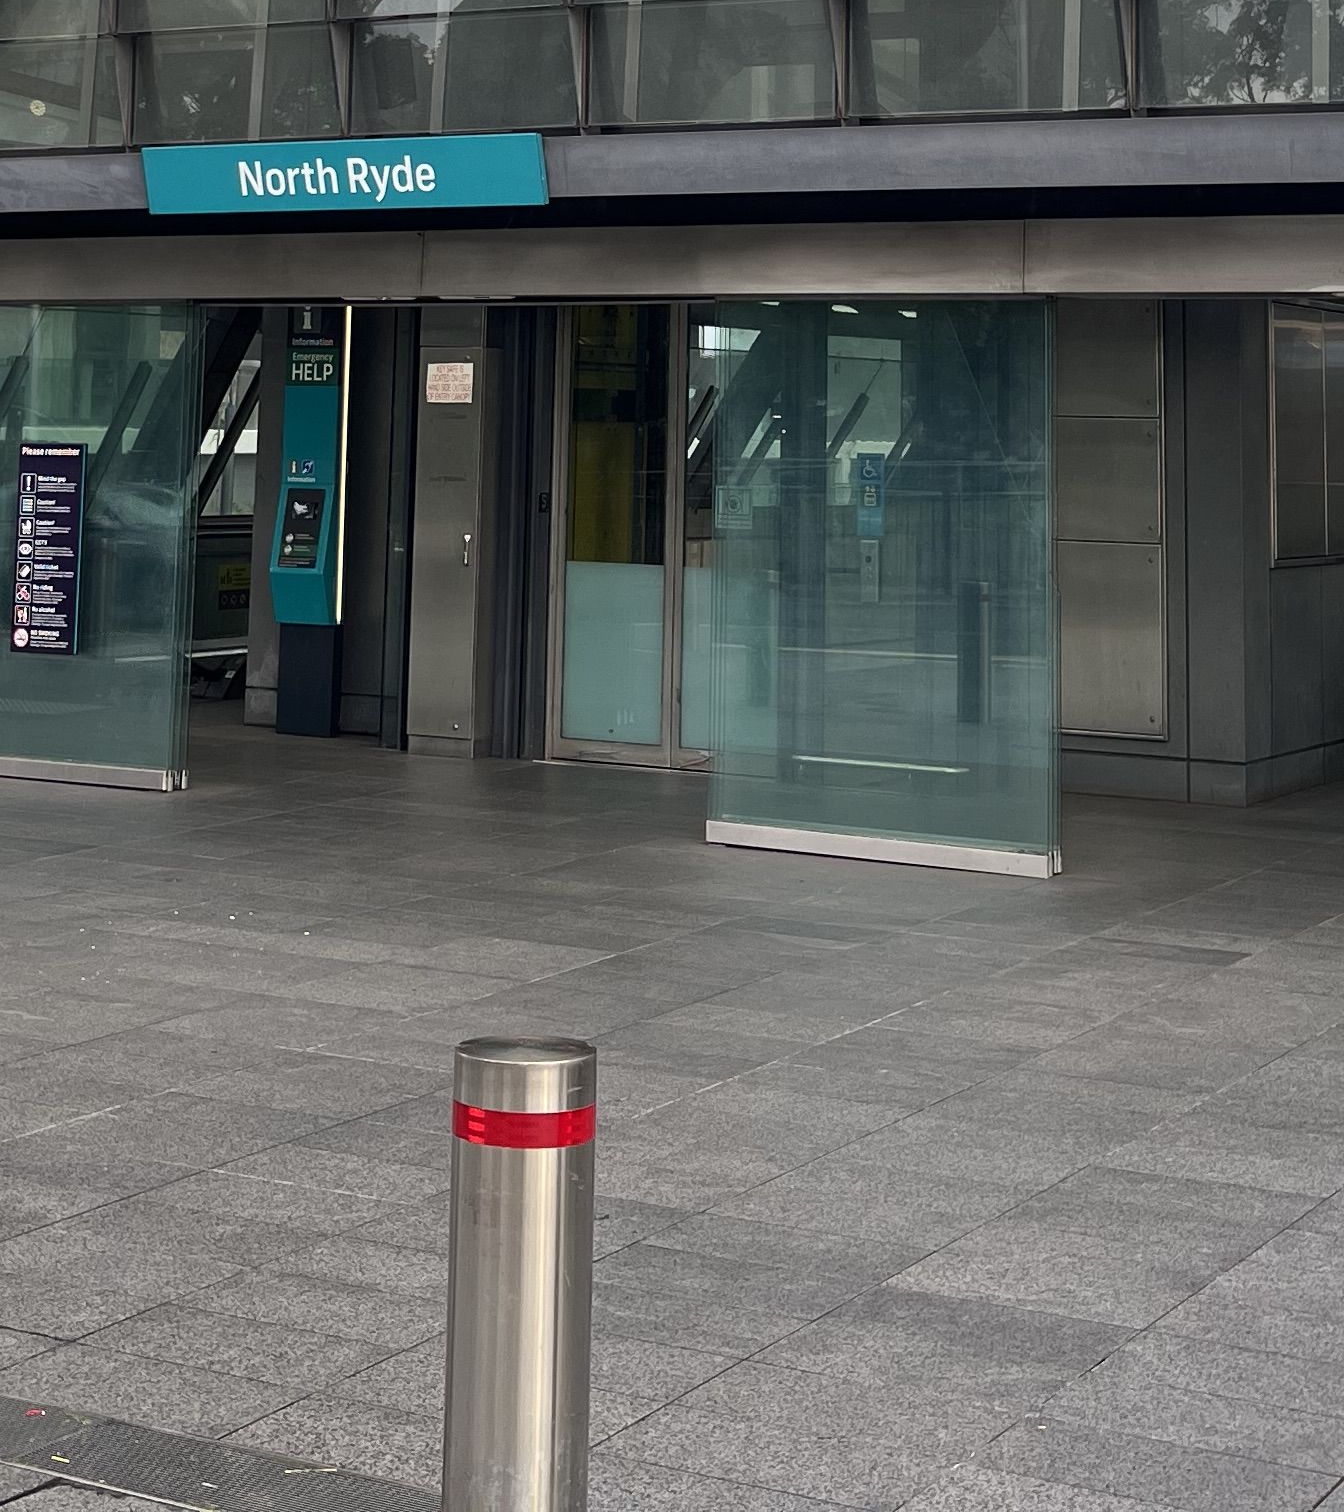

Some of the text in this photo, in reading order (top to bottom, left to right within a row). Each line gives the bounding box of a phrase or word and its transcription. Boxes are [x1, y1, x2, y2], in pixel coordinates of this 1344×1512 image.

[237, 155, 436, 203] North Ryde
[292, 338, 334, 347] Information
[292, 352, 334, 364] Emergency
[291, 363, 334, 381] HELP
[21, 446, 80, 457] Please remember
